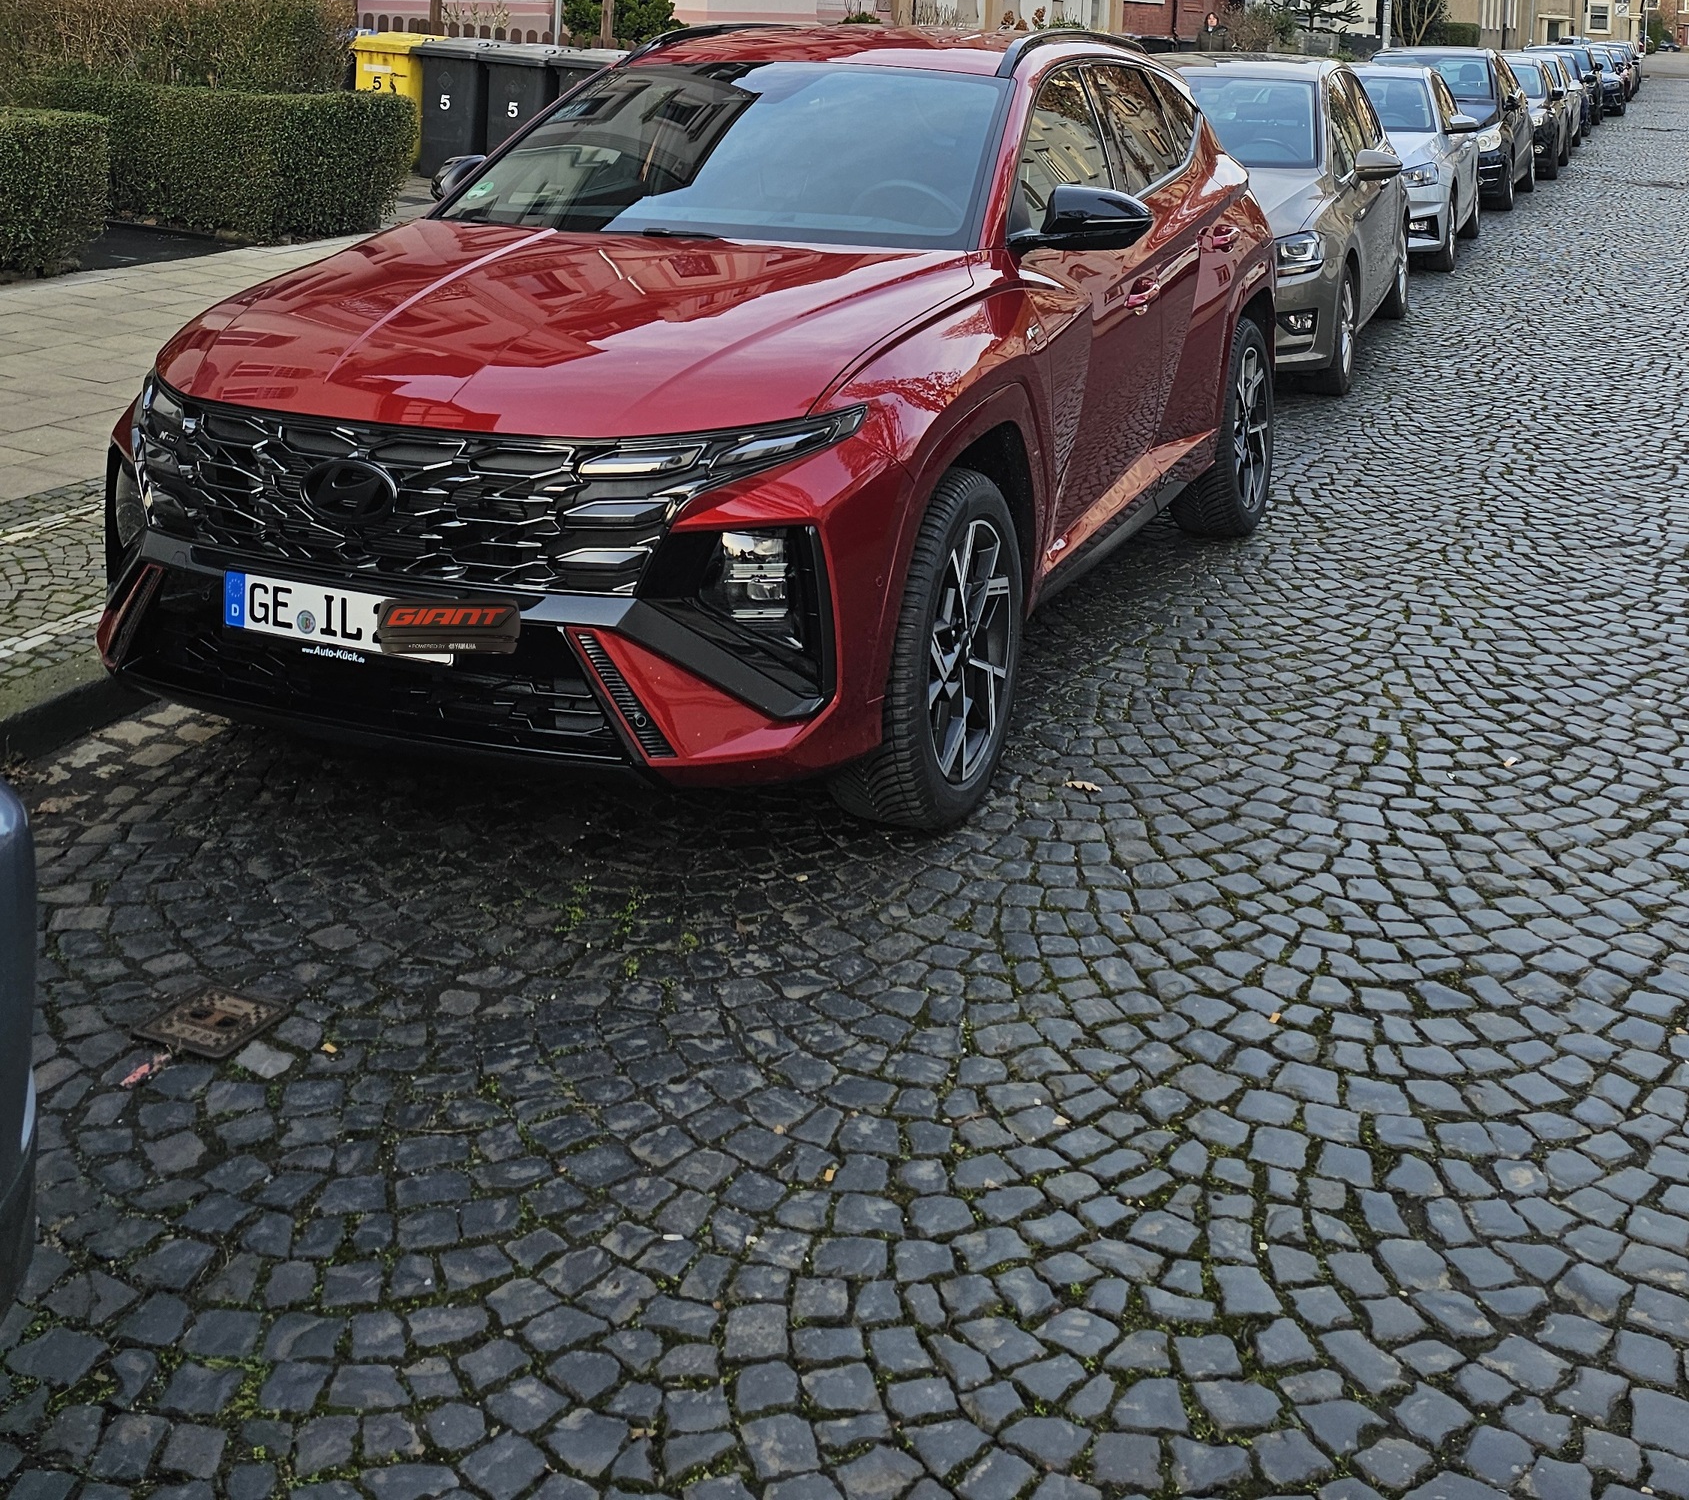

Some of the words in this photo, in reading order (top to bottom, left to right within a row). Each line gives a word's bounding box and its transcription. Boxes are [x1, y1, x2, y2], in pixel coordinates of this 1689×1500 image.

[373, 76, 382, 90] 5
[440, 94, 451, 110] 5
[507, 101, 519, 118] 5
[231, 604, 239, 616] D
[249, 582, 293, 629] GE
[320, 594, 363, 641] IL
